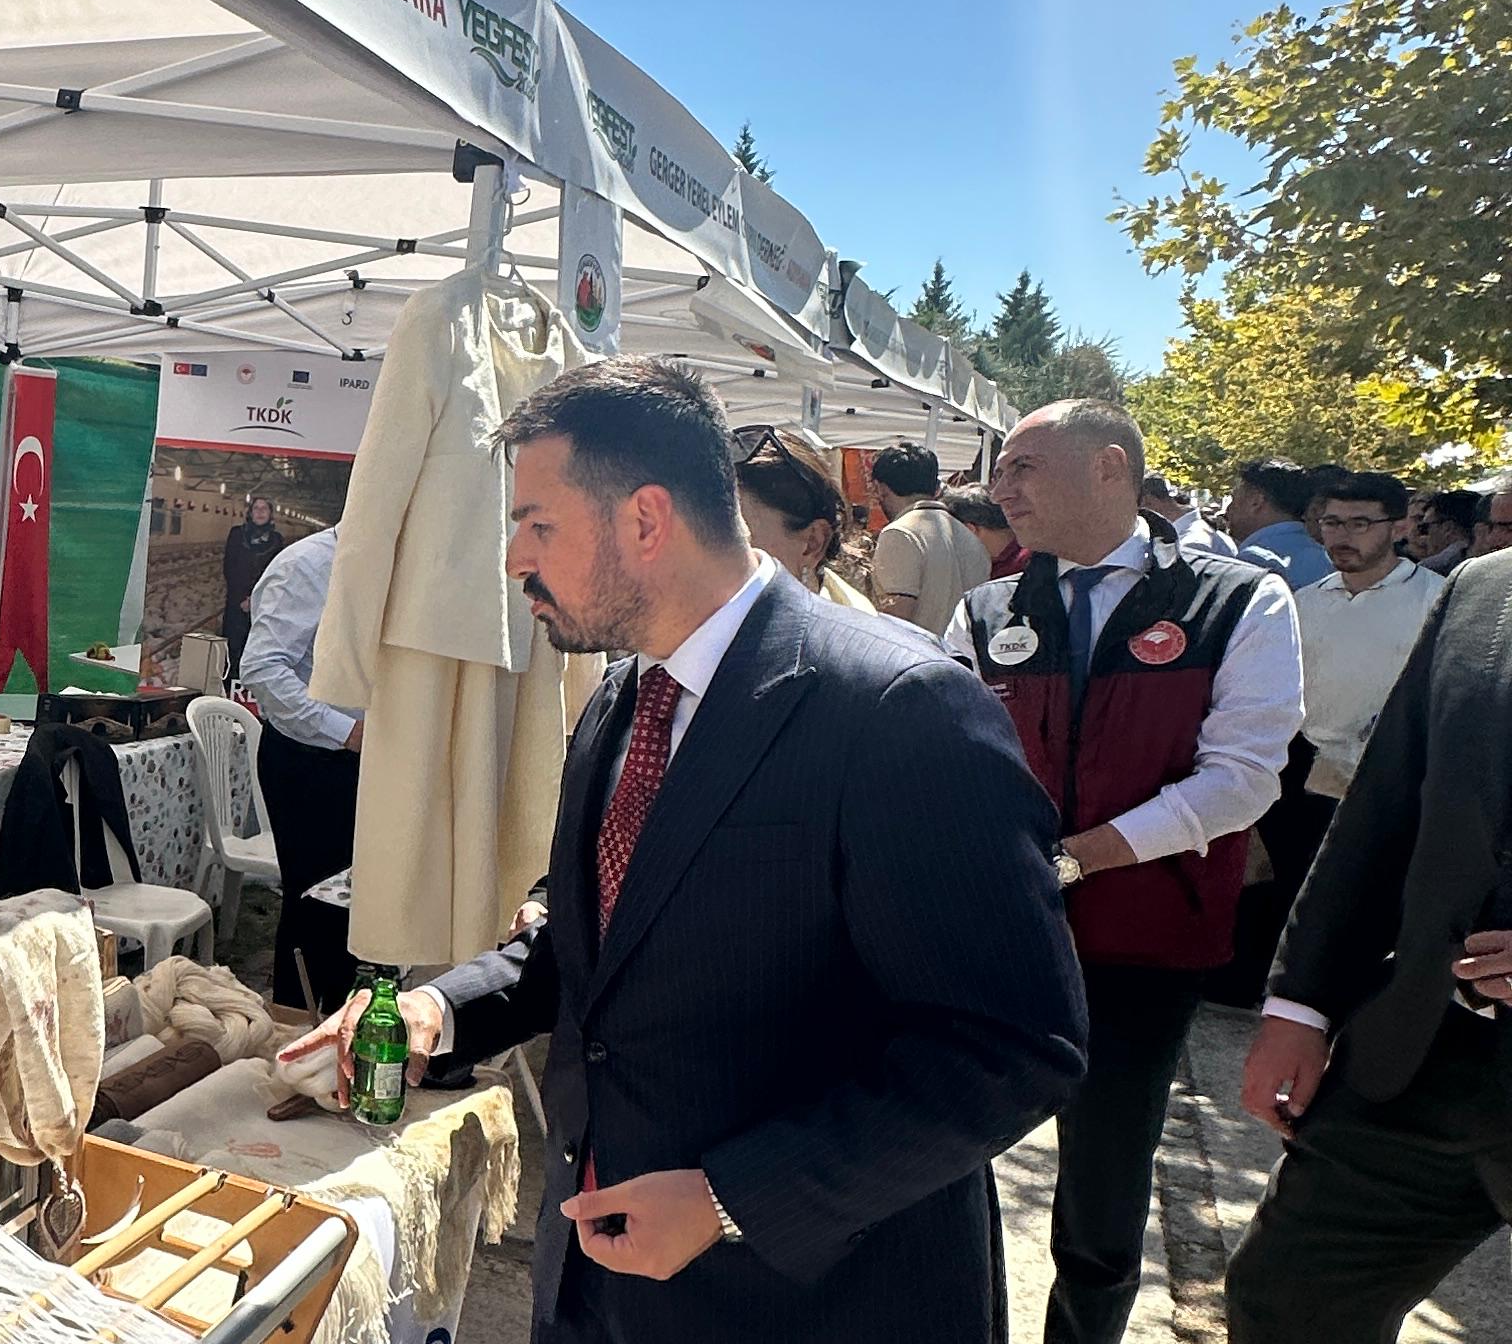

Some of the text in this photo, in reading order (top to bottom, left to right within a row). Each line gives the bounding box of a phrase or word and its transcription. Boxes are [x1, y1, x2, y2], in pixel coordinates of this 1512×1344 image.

[649, 145, 686, 199] GERGER
[687, 173, 711, 217] YEREL
[339, 377, 370, 390] IPARD
[246, 406, 293, 425] TKDK
[999, 640, 1028, 652] TKDK
